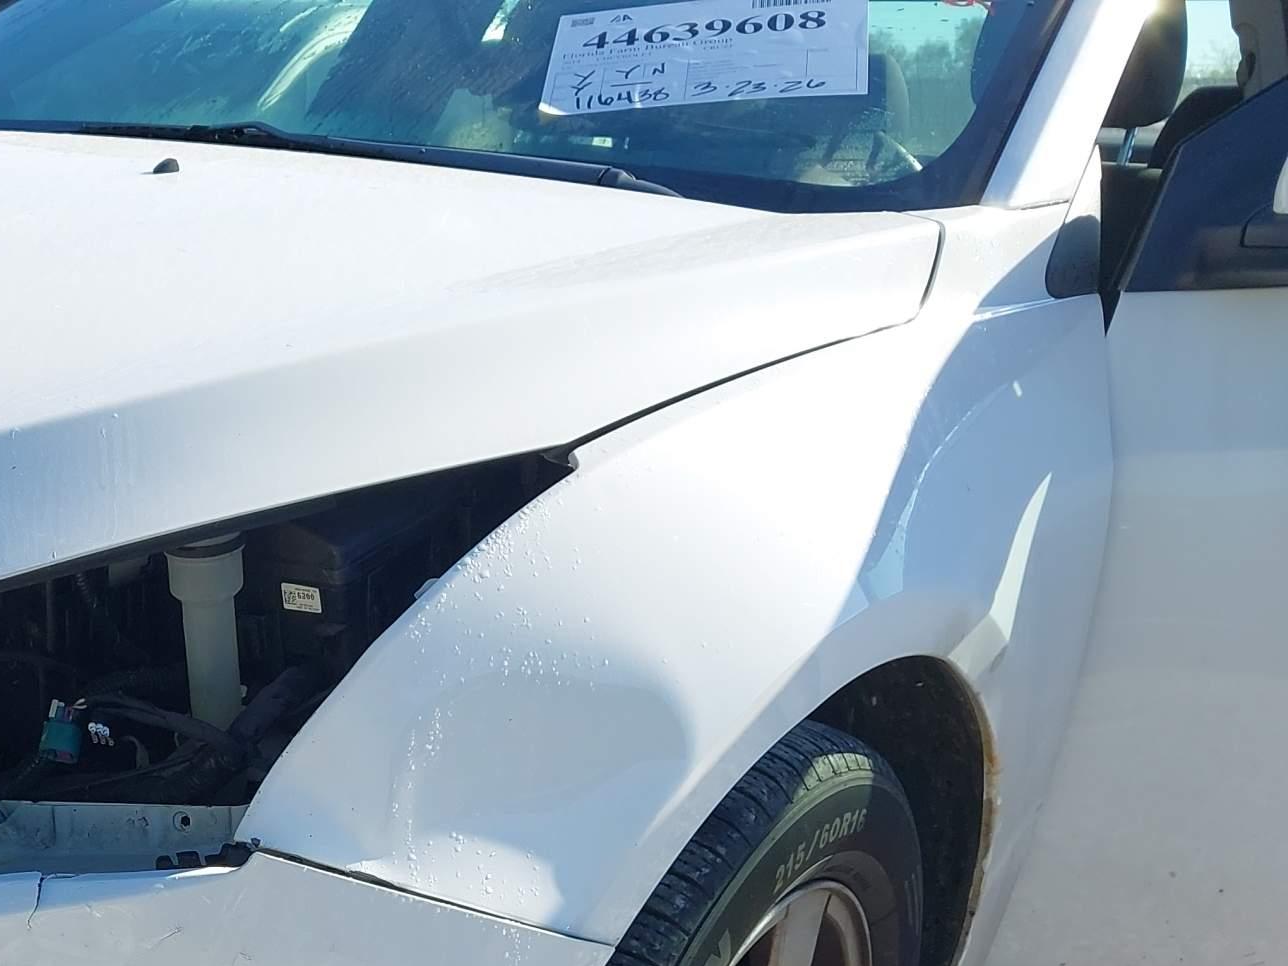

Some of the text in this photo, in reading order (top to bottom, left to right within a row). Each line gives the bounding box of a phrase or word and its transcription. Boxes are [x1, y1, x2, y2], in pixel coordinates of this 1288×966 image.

[582, 10, 826, 49] 44639608
[652, 62, 666, 75] N
[772, 807, 867, 896] 215/60R16
